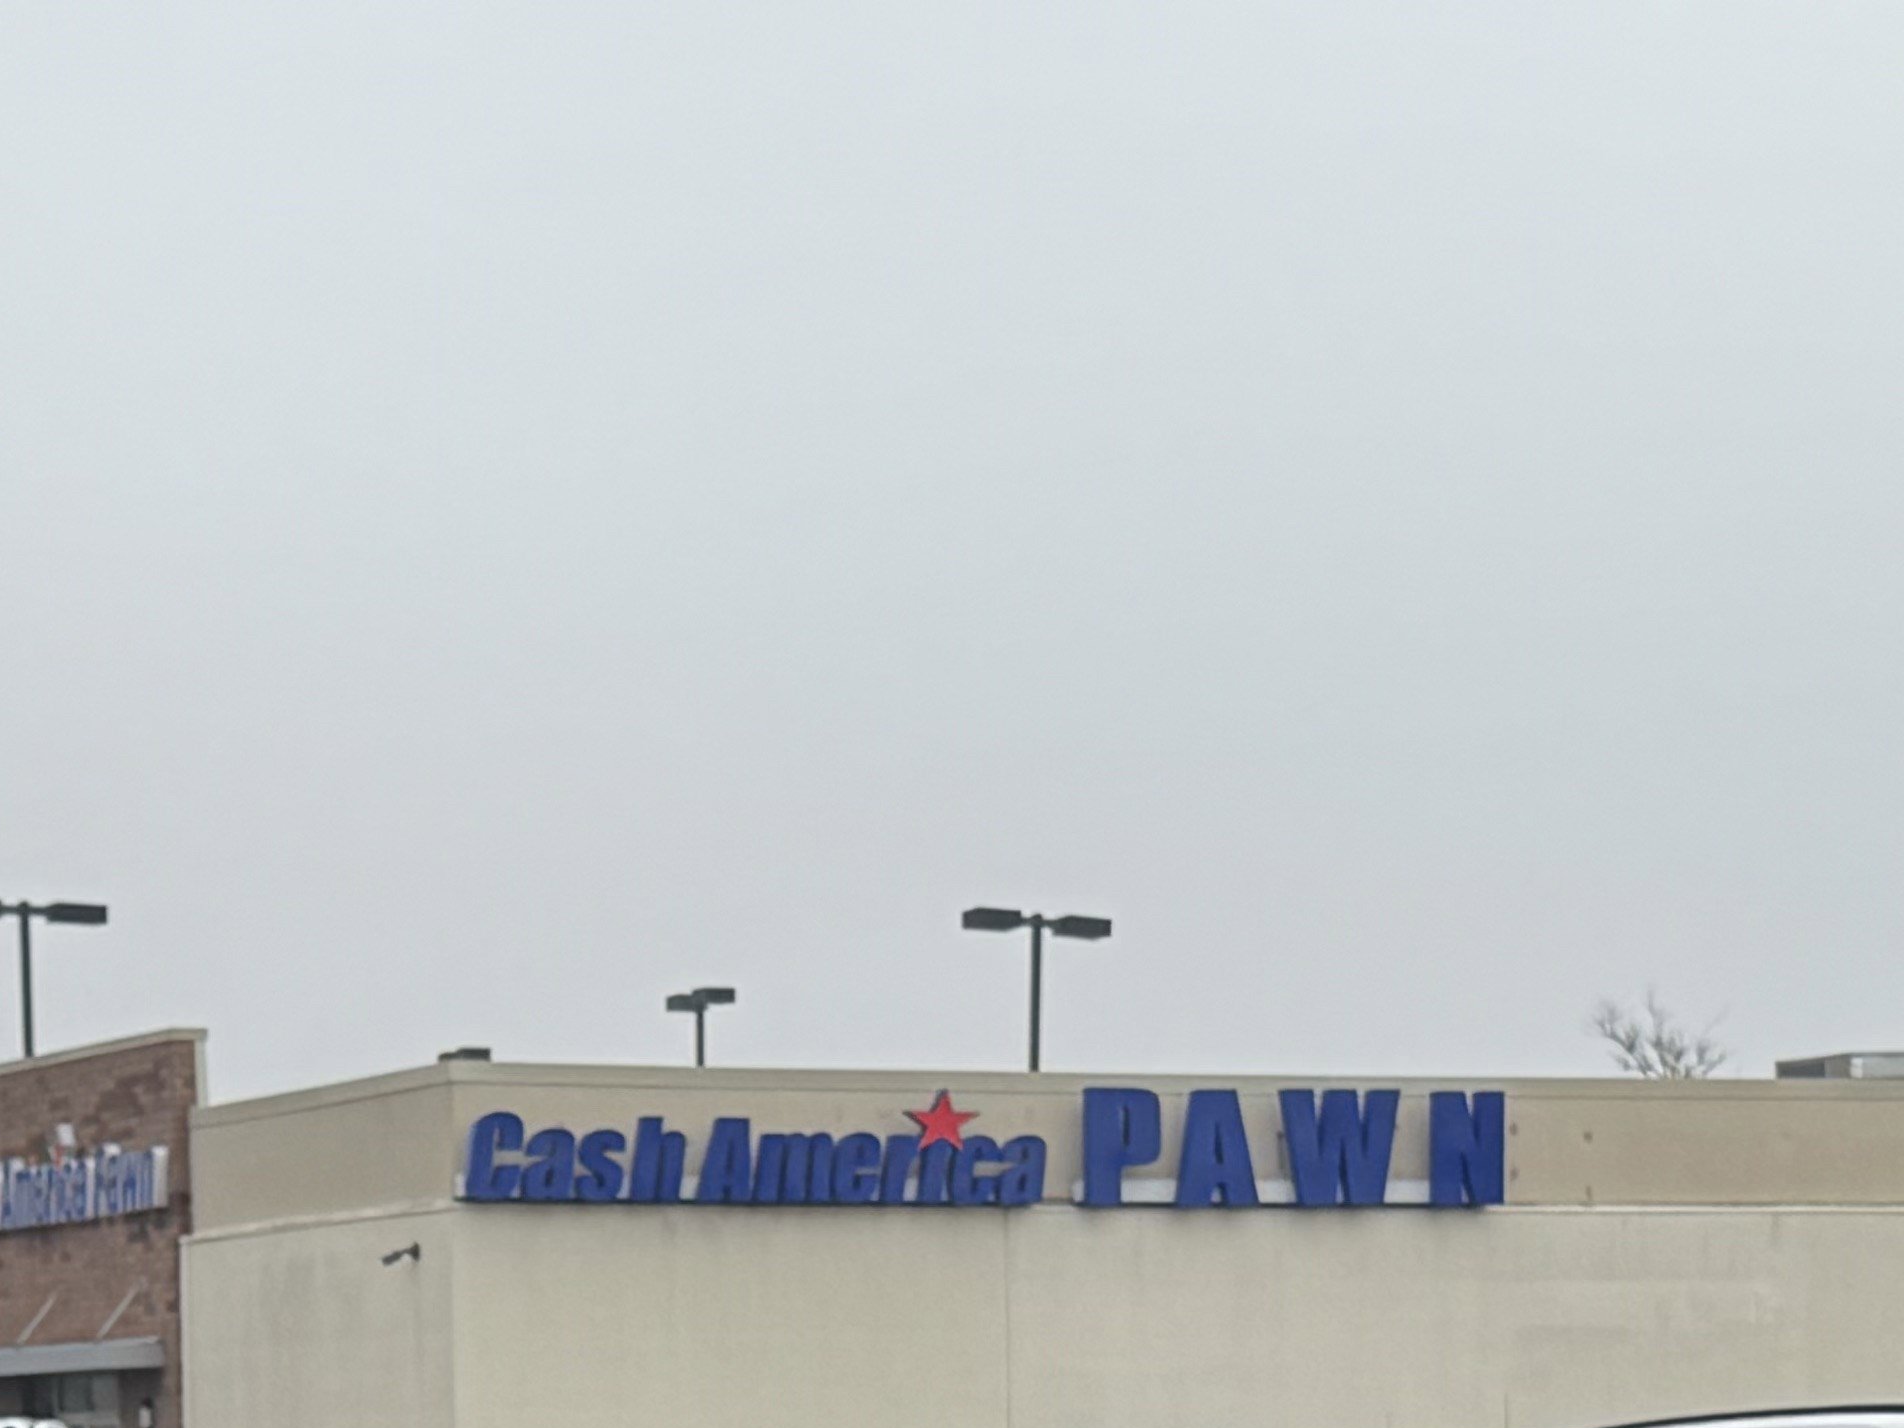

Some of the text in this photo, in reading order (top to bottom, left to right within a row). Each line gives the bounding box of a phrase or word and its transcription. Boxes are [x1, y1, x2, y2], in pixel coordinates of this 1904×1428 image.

[464, 1086, 1506, 1206] Cash America PAWN
